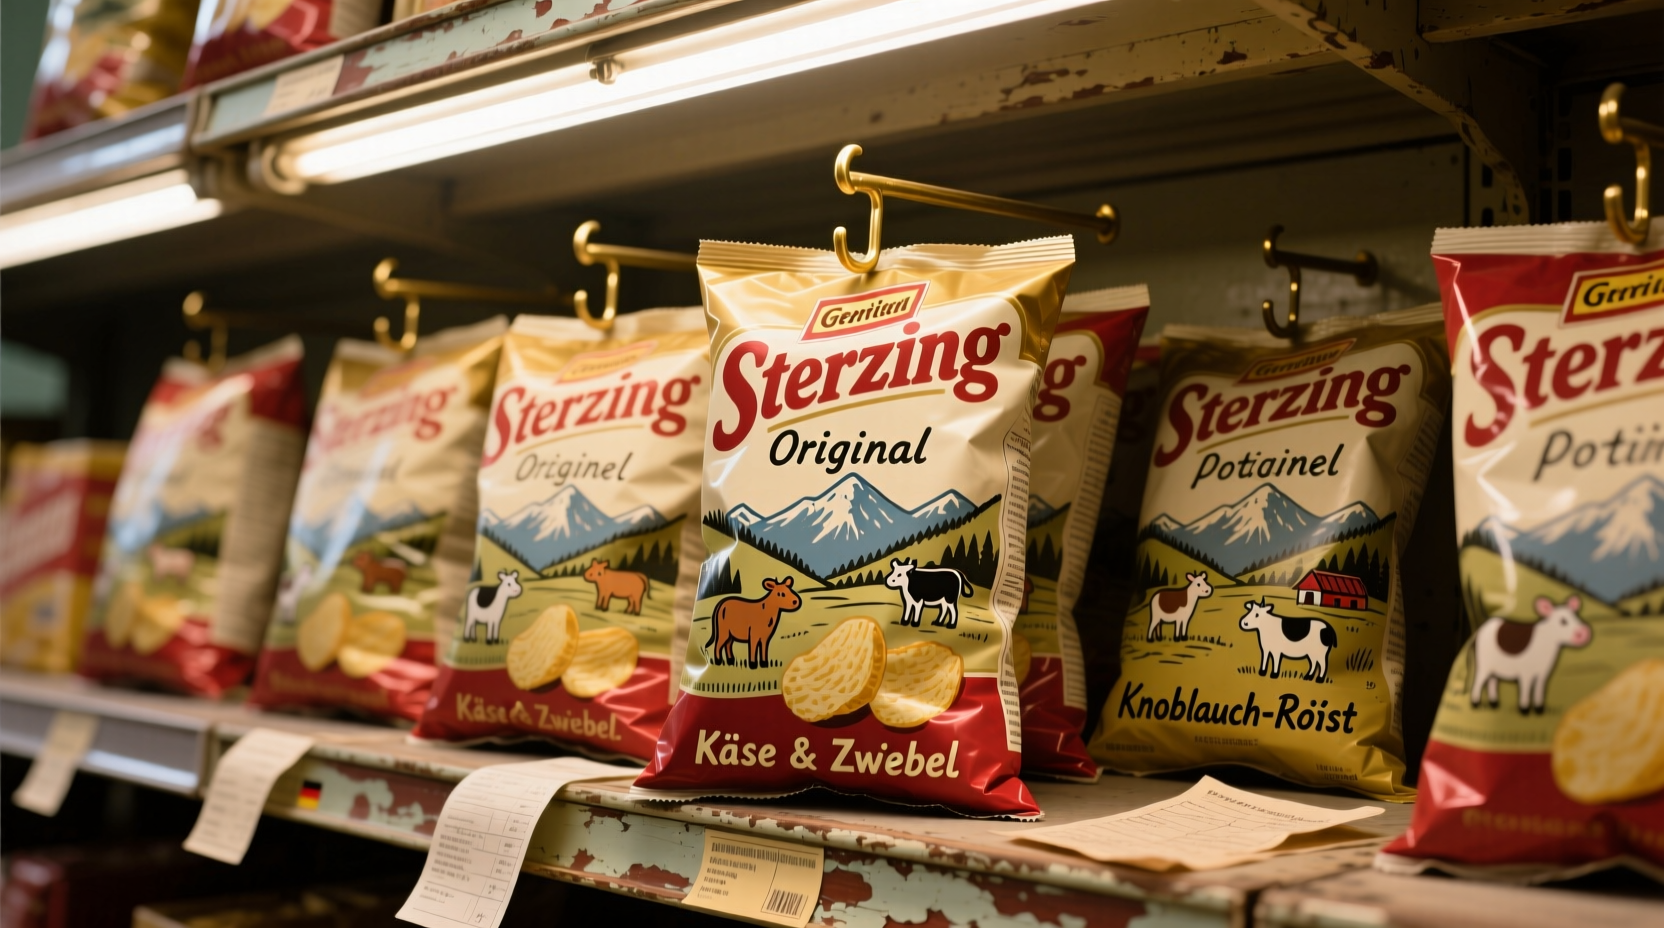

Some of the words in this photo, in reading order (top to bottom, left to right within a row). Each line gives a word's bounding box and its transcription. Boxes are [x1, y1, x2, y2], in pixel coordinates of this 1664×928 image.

[481, 372, 702, 468] Sterzing
[712, 321, 1011, 452] Sterzing
[1153, 364, 1411, 468] Sterzing
[769, 427, 932, 474] Original
[695, 729, 777, 768] Käse
[789, 736, 817, 771] &
[830, 738, 960, 778] Zwiebel
